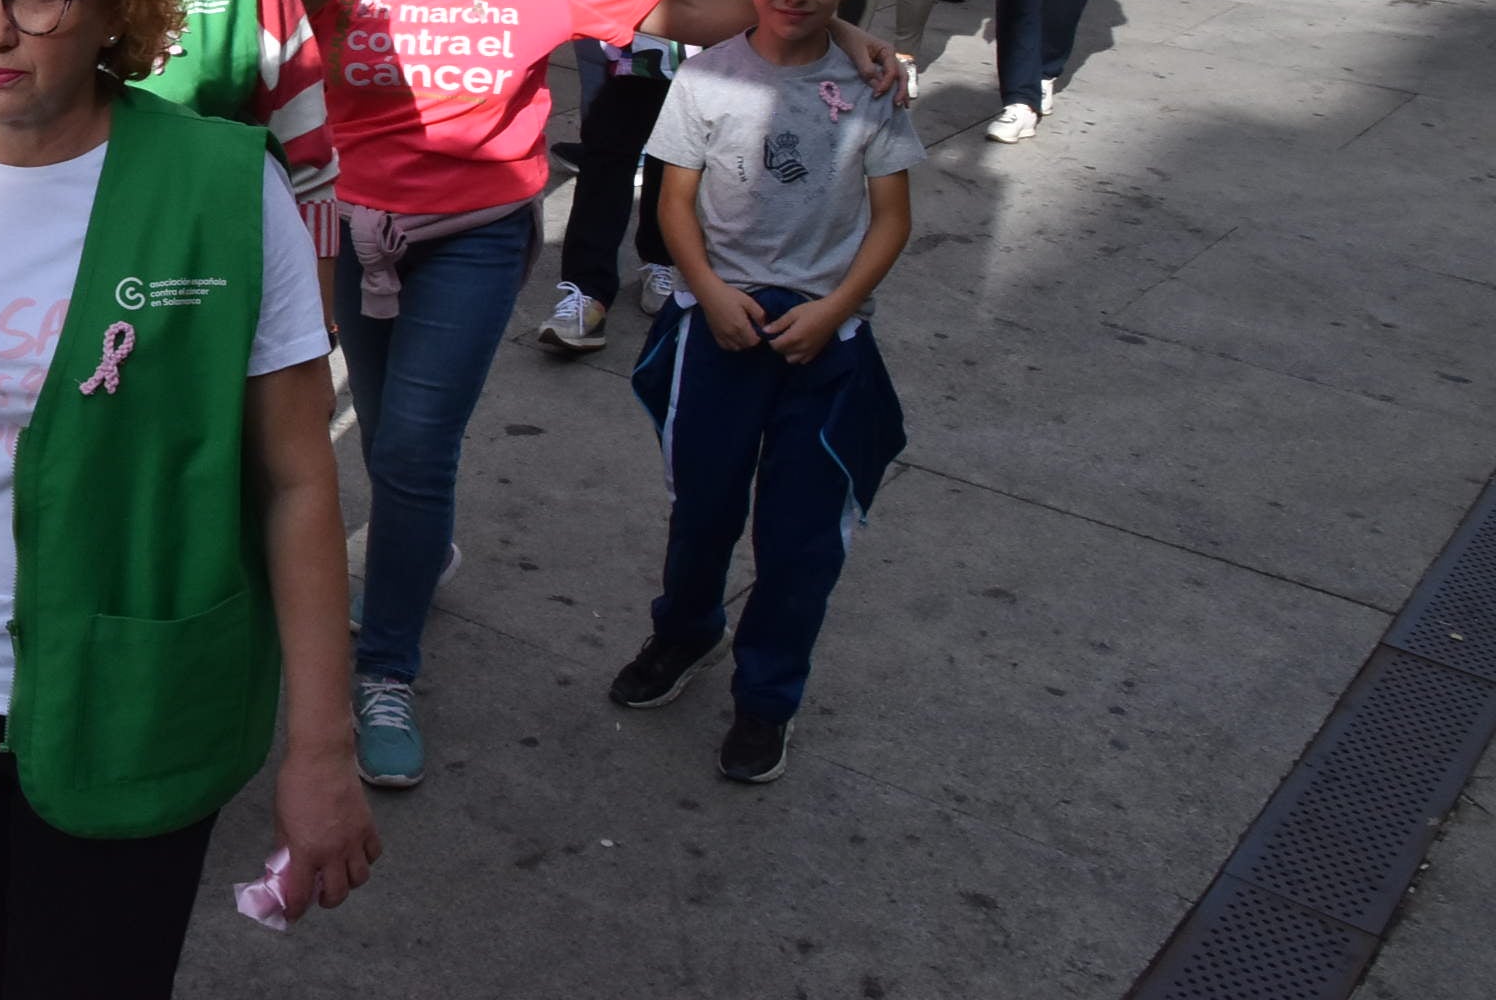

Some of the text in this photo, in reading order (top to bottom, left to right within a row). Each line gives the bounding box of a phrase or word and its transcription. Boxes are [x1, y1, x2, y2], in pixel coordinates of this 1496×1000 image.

[399, 1, 519, 26] marcha
[347, 29, 514, 59] contra el
[345, 55, 513, 95] cáncer
